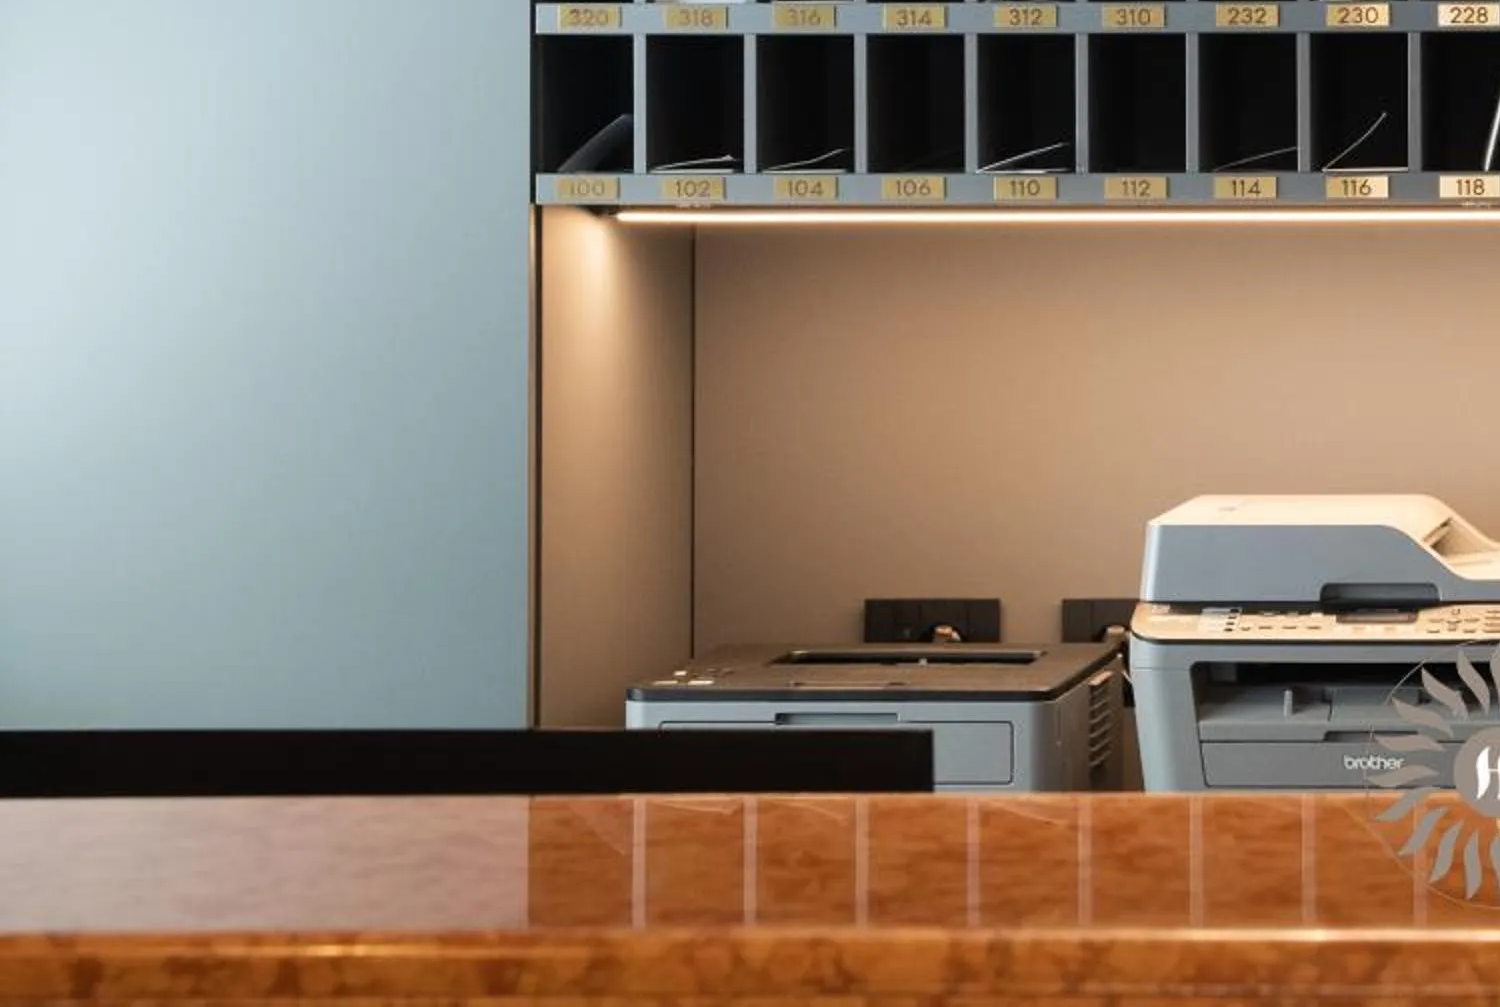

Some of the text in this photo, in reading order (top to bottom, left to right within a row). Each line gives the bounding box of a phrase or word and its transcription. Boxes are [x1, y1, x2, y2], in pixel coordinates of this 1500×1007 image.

[569, 9, 609, 26] 320
[678, 9, 713, 26] 318
[787, 9, 820, 26] 316
[897, 9, 932, 26] 314
[1009, 8, 1042, 25] 312
[1116, 8, 1150, 25] 310
[1228, 7, 1266, 25] 232
[1338, 6, 1378, 24] 230
[1450, 6, 1488, 24] 228
[569, 181, 605, 197] 100
[676, 181, 710, 197] 102
[787, 181, 823, 197] 104
[896, 180, 931, 197] 106
[1010, 180, 1040, 197] 110
[1122, 180, 1151, 196] 112
[1231, 179, 1261, 196] 114
[1342, 179, 1372, 195] 116
[1456, 179, 1485, 195] 118
[1343, 754, 1404, 769] brother
